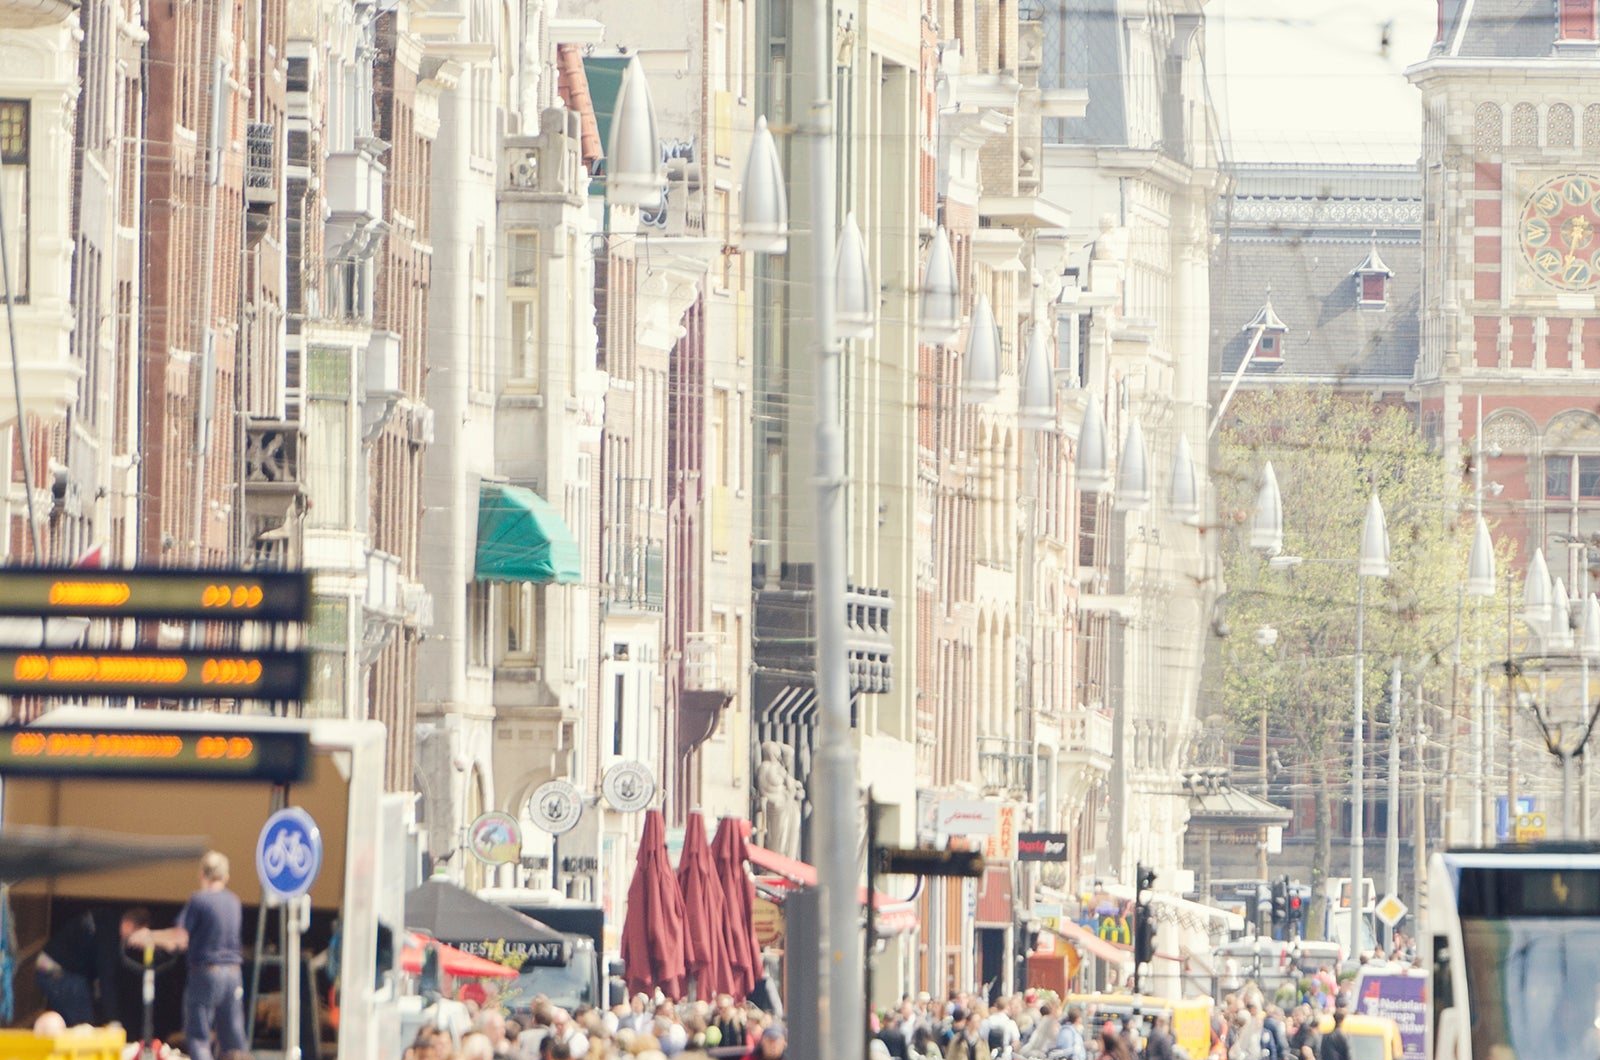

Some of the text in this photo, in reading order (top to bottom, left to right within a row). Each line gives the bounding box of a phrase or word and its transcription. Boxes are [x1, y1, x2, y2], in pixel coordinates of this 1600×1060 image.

[1568, 182, 1586, 201] N
[1001, 807, 1014, 857] MARKT
[460, 942, 562, 957] RESURANT
